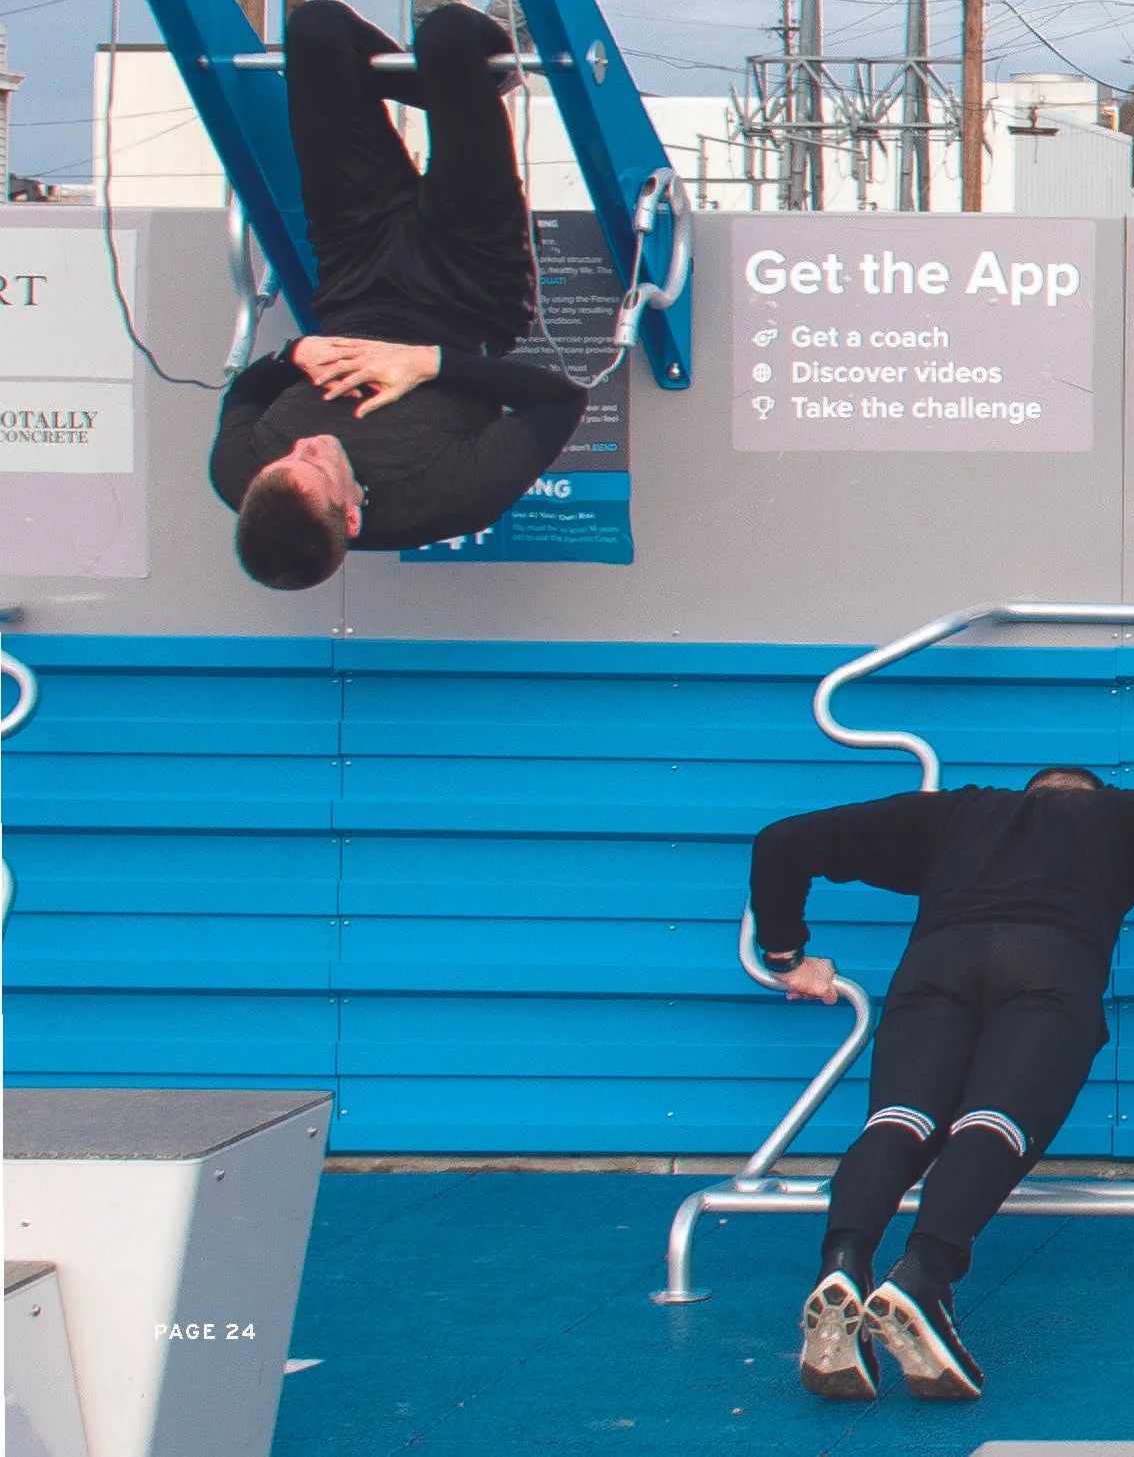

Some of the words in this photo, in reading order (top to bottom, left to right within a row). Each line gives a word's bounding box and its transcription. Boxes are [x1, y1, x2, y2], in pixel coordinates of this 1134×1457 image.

[745, 249, 844, 296] Get
[859, 249, 950, 296] the
[965, 250, 1081, 306] App
[791, 325, 839, 349] Get
[846, 331, 862, 348] a
[869, 325, 950, 349] coach
[792, 361, 908, 384] Discover
[914, 361, 1003, 385] videos
[791, 396, 854, 419] Take
[861, 396, 905, 419] the
[911, 396, 1043, 426] challenge
